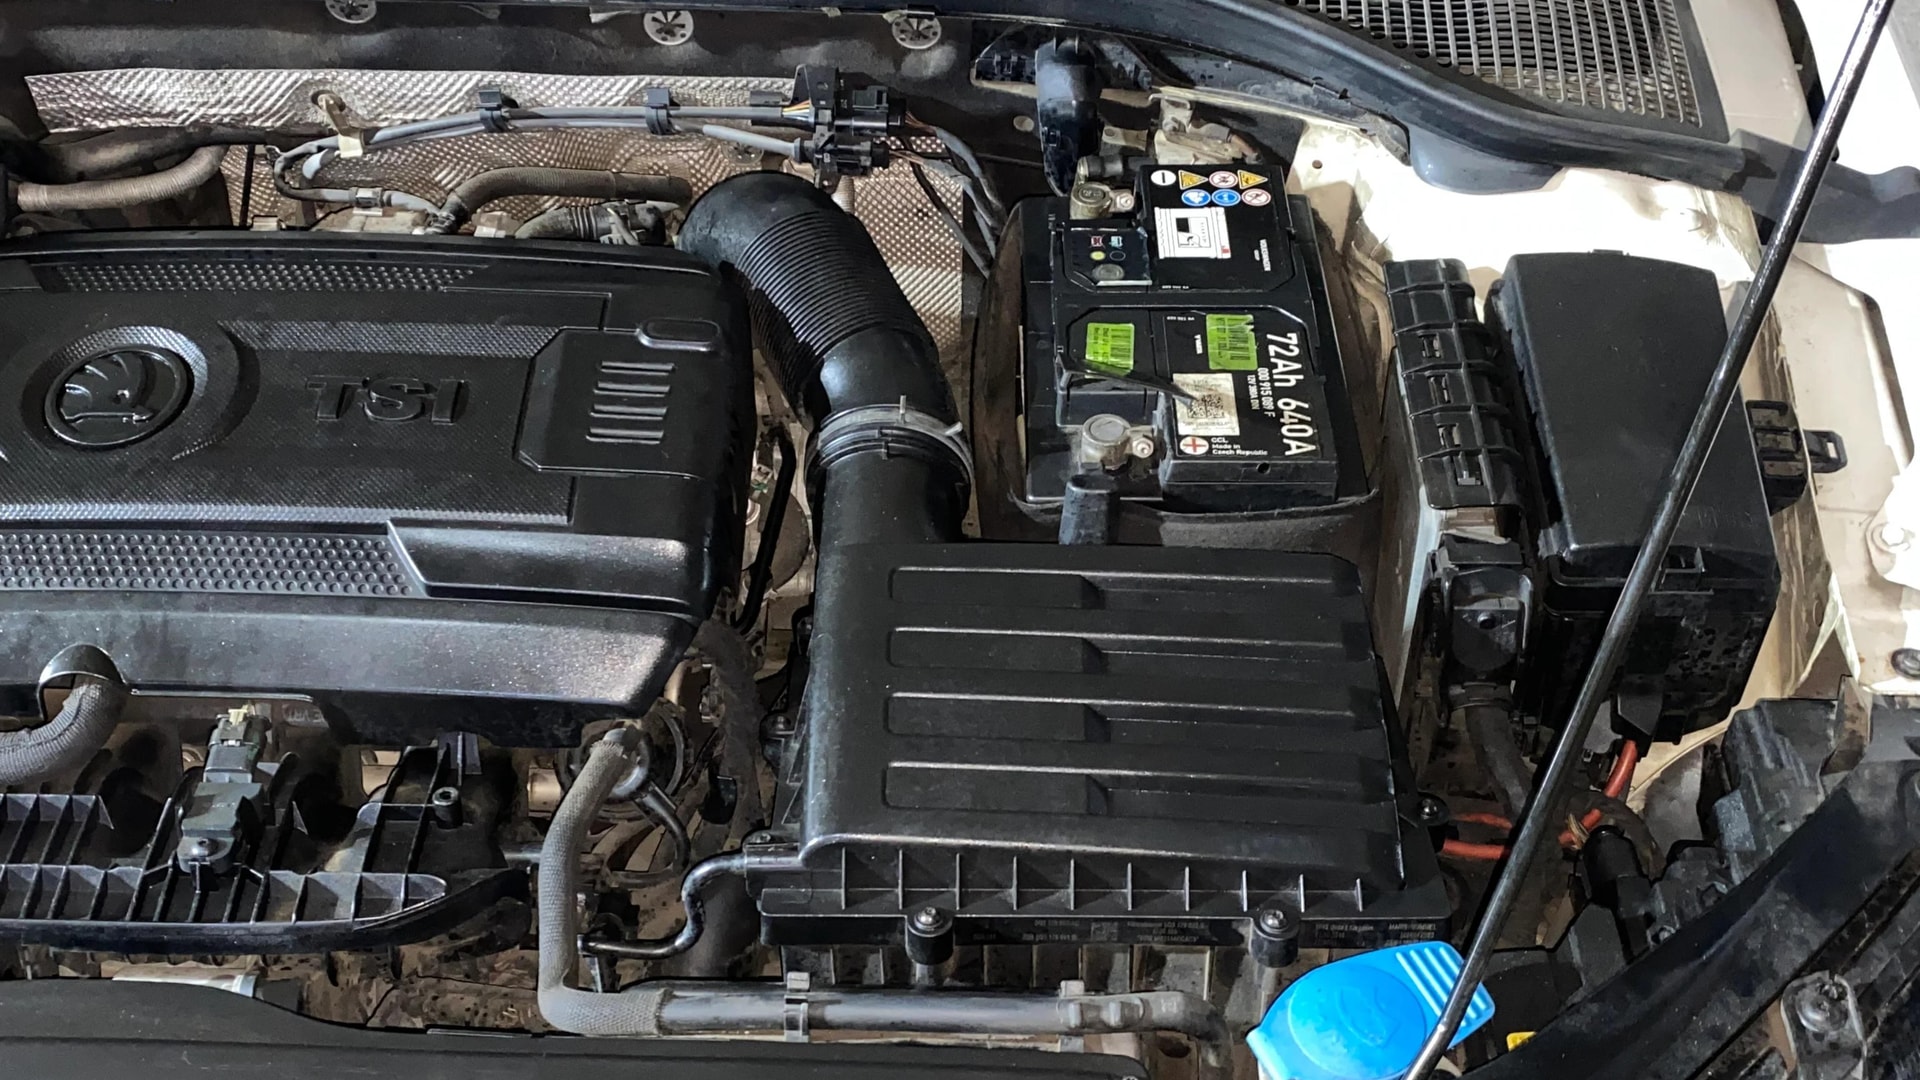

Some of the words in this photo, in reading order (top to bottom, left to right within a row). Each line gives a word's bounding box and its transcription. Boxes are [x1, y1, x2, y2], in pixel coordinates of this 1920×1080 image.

[1257, 367, 1270, 381] 000
[1266, 332, 1304, 387] 72Ah
[307, 375, 464, 425] TSI
[1259, 382, 1272, 396] 915
[1277, 398, 1316, 455] 640A
